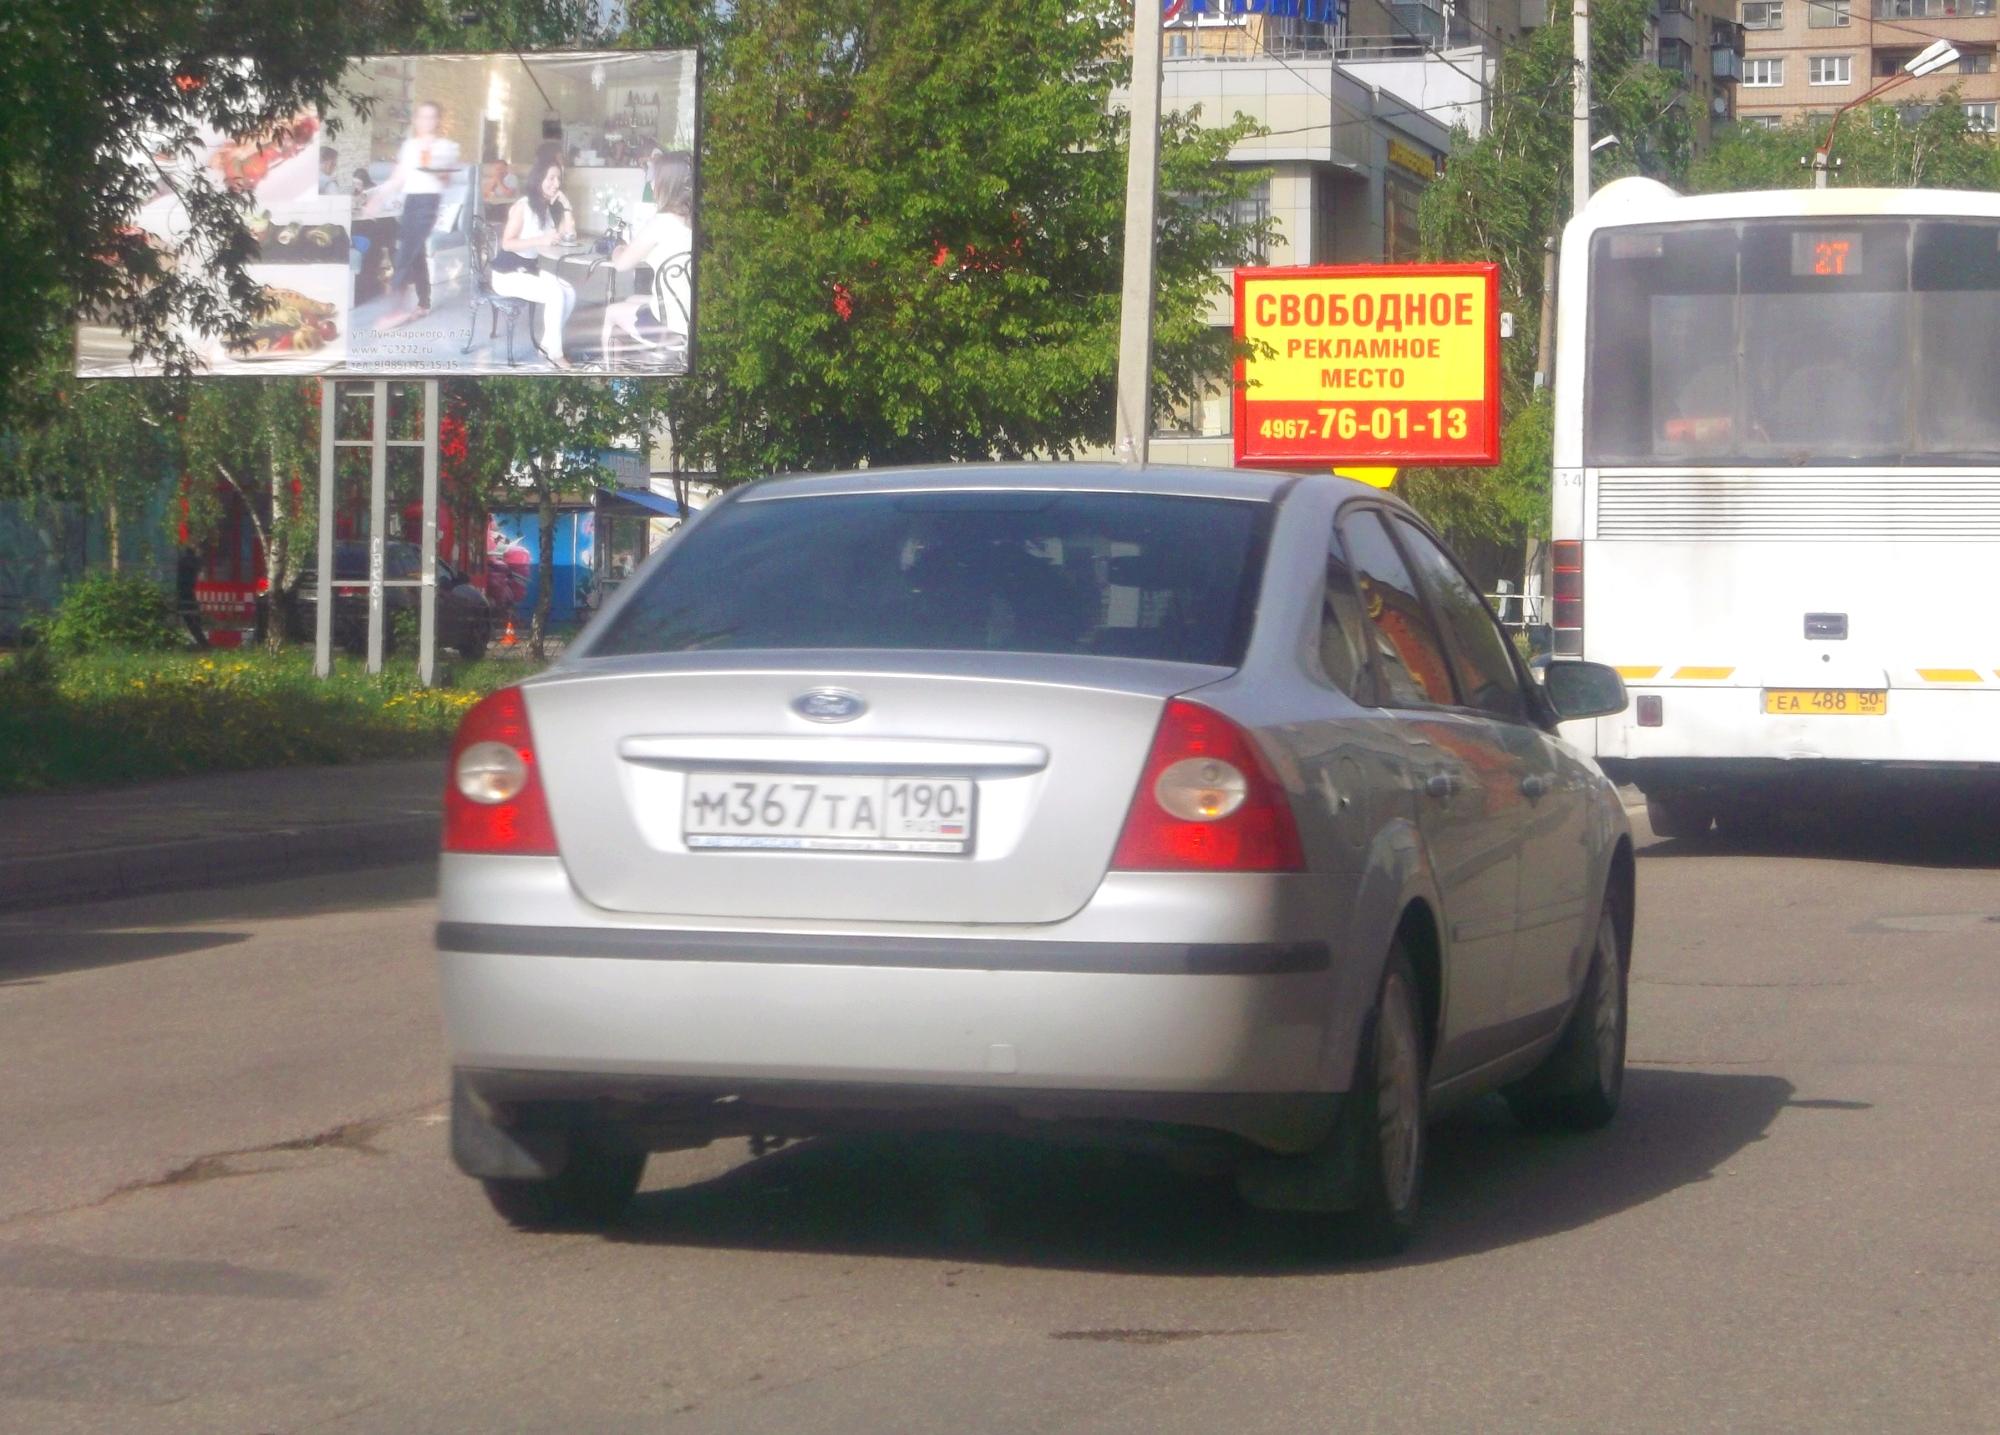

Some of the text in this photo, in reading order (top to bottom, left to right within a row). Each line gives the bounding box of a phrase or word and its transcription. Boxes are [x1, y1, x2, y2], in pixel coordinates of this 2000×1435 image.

[1815, 241, 1849, 274] 27
[1255, 292, 1473, 333] СВОБОДНОЕ
[1286, 338, 1441, 359] РЕКЛАМНОЕ
[1320, 368, 1405, 389] МЕСТО
[1259, 407, 1468, 440] 4967-76-01-13
[1811, 691, 1847, 710] 488
[1859, 691, 1879, 706] 50
[697, 782, 957, 830] М367ТА 190
